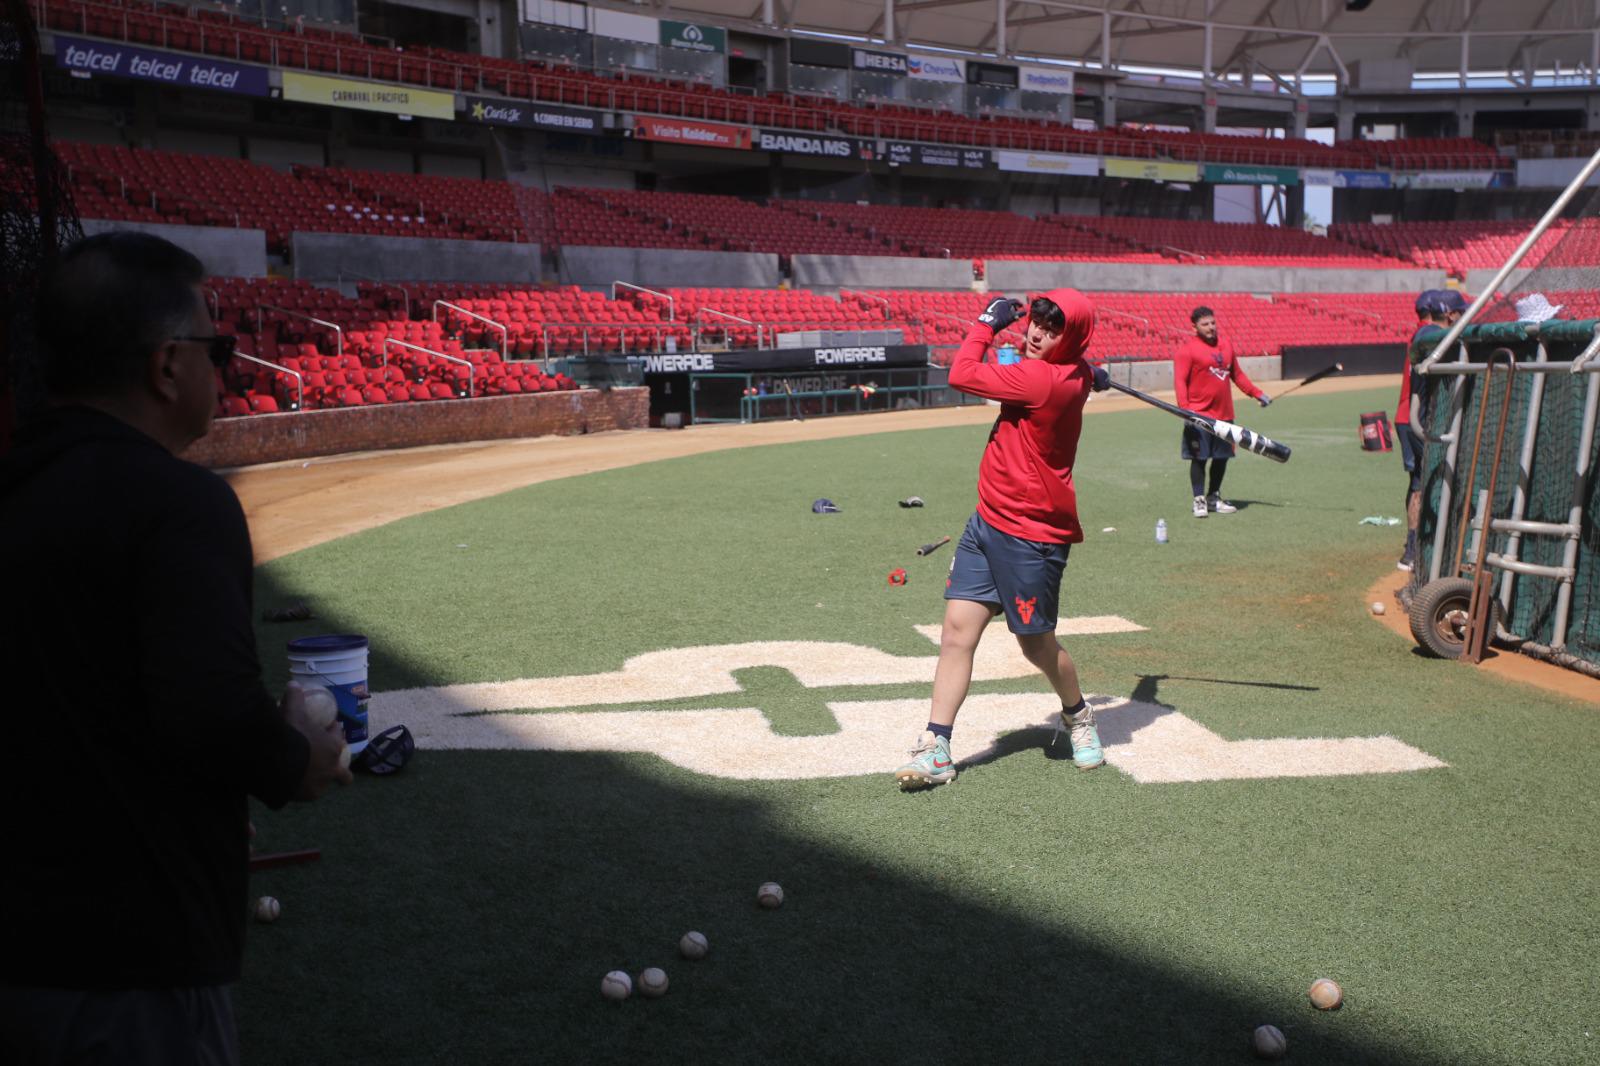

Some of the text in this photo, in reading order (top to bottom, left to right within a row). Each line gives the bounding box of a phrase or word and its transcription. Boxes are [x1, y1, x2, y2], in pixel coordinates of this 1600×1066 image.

[64, 45, 239, 88] telcel telcel telcel
[866, 55, 907, 72] HERSA
[815, 347, 887, 365] POWERADE
